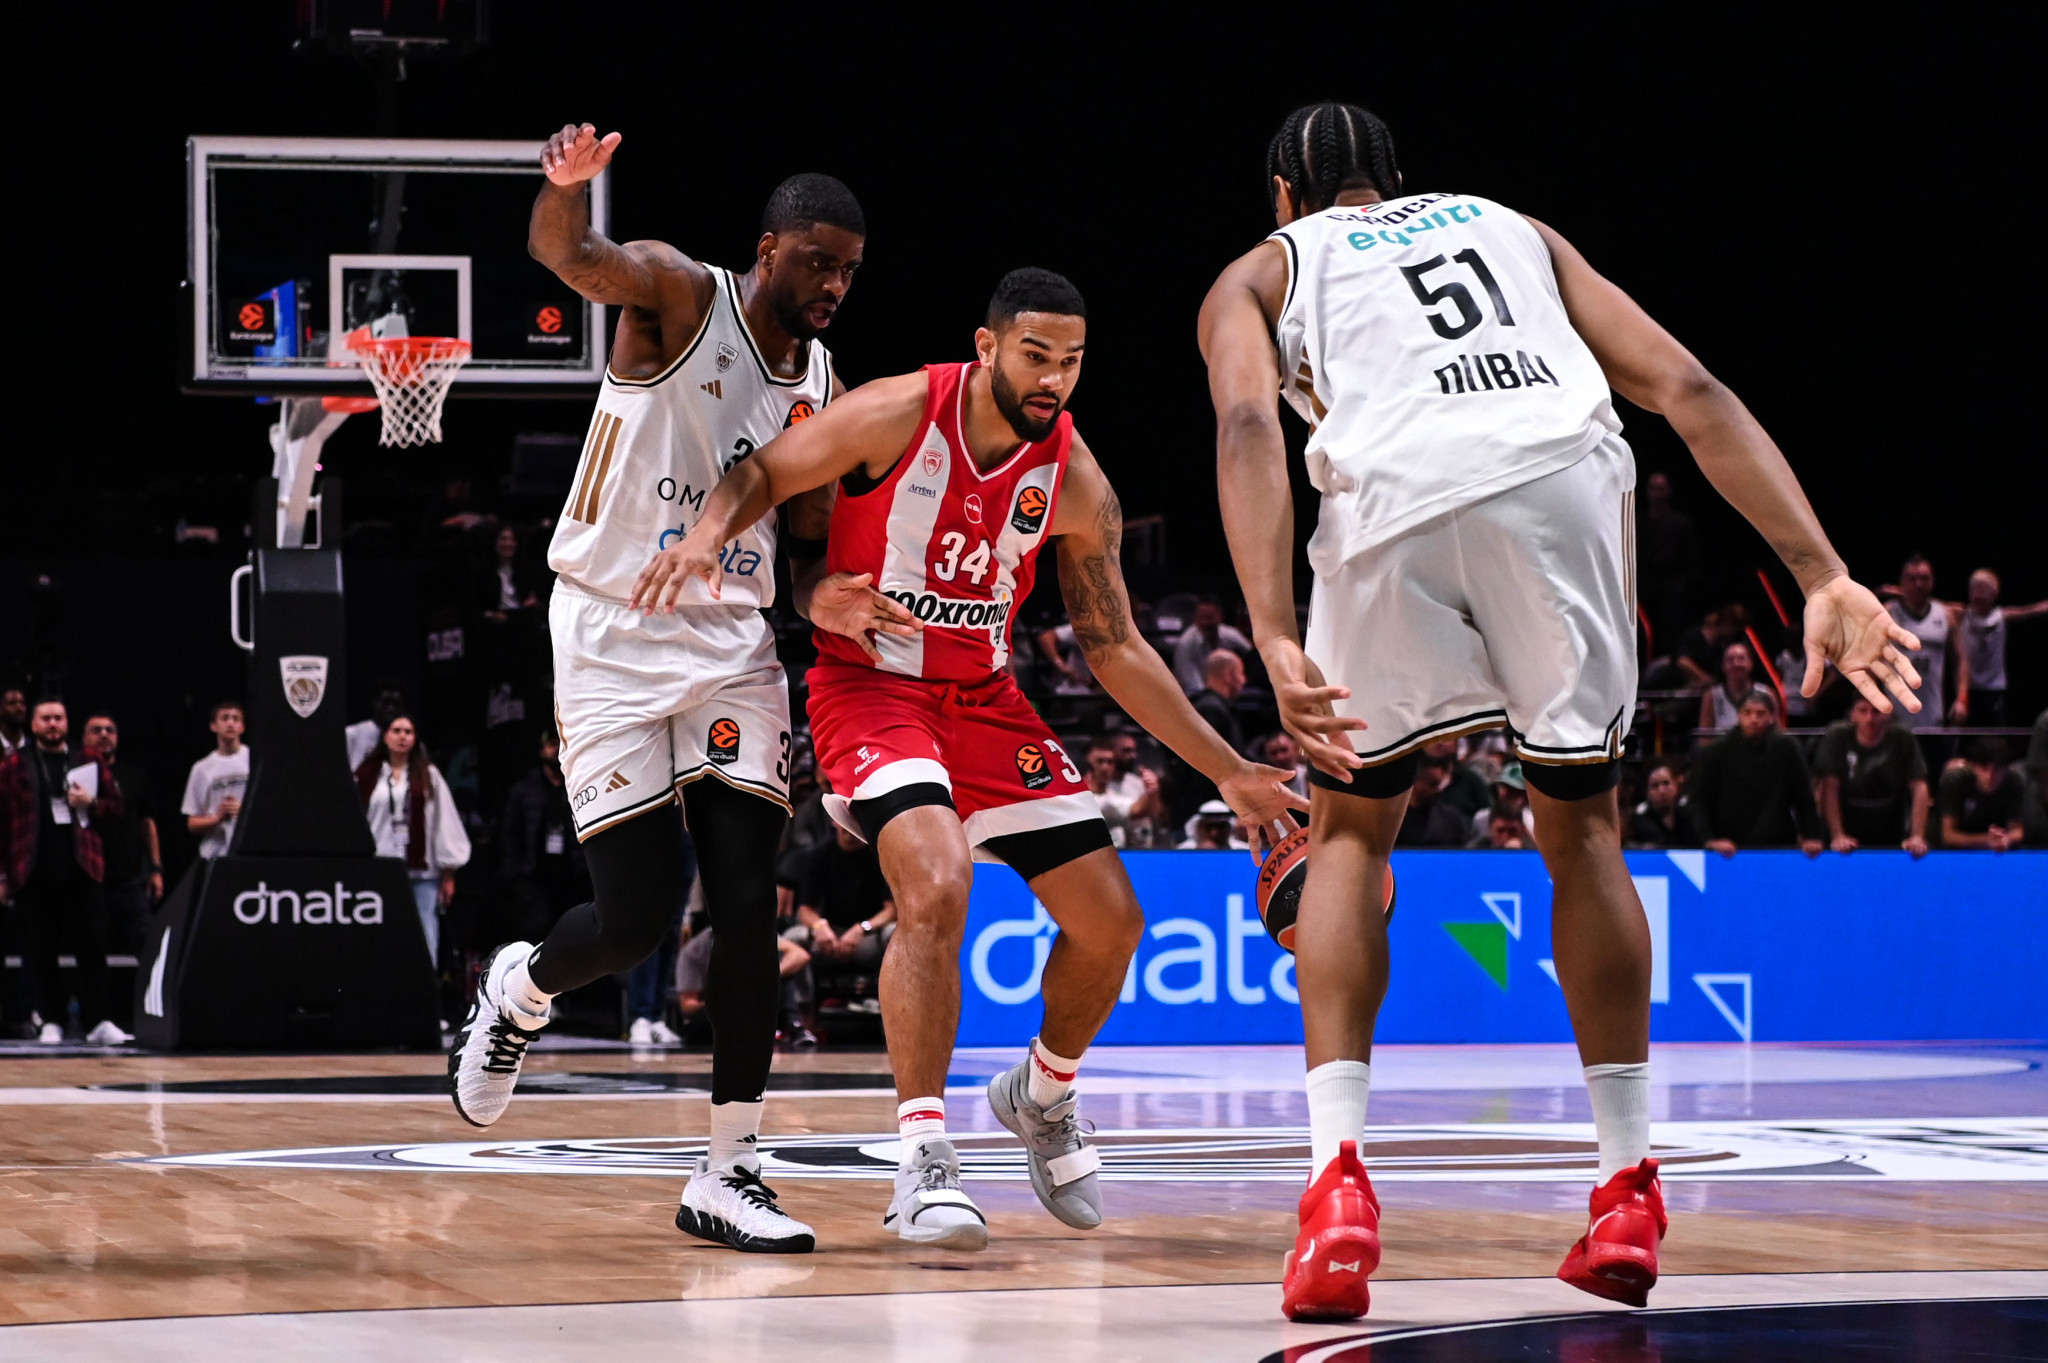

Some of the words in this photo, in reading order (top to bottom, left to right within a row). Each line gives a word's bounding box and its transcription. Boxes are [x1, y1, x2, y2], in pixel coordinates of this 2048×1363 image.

[1398, 247, 1516, 340] 51
[934, 531, 991, 585] 34
[776, 730, 792, 785] 3
[1043, 738, 1083, 784] 3
[1261, 831, 1309, 889] SPALD
[233, 881, 384, 924] dnata
